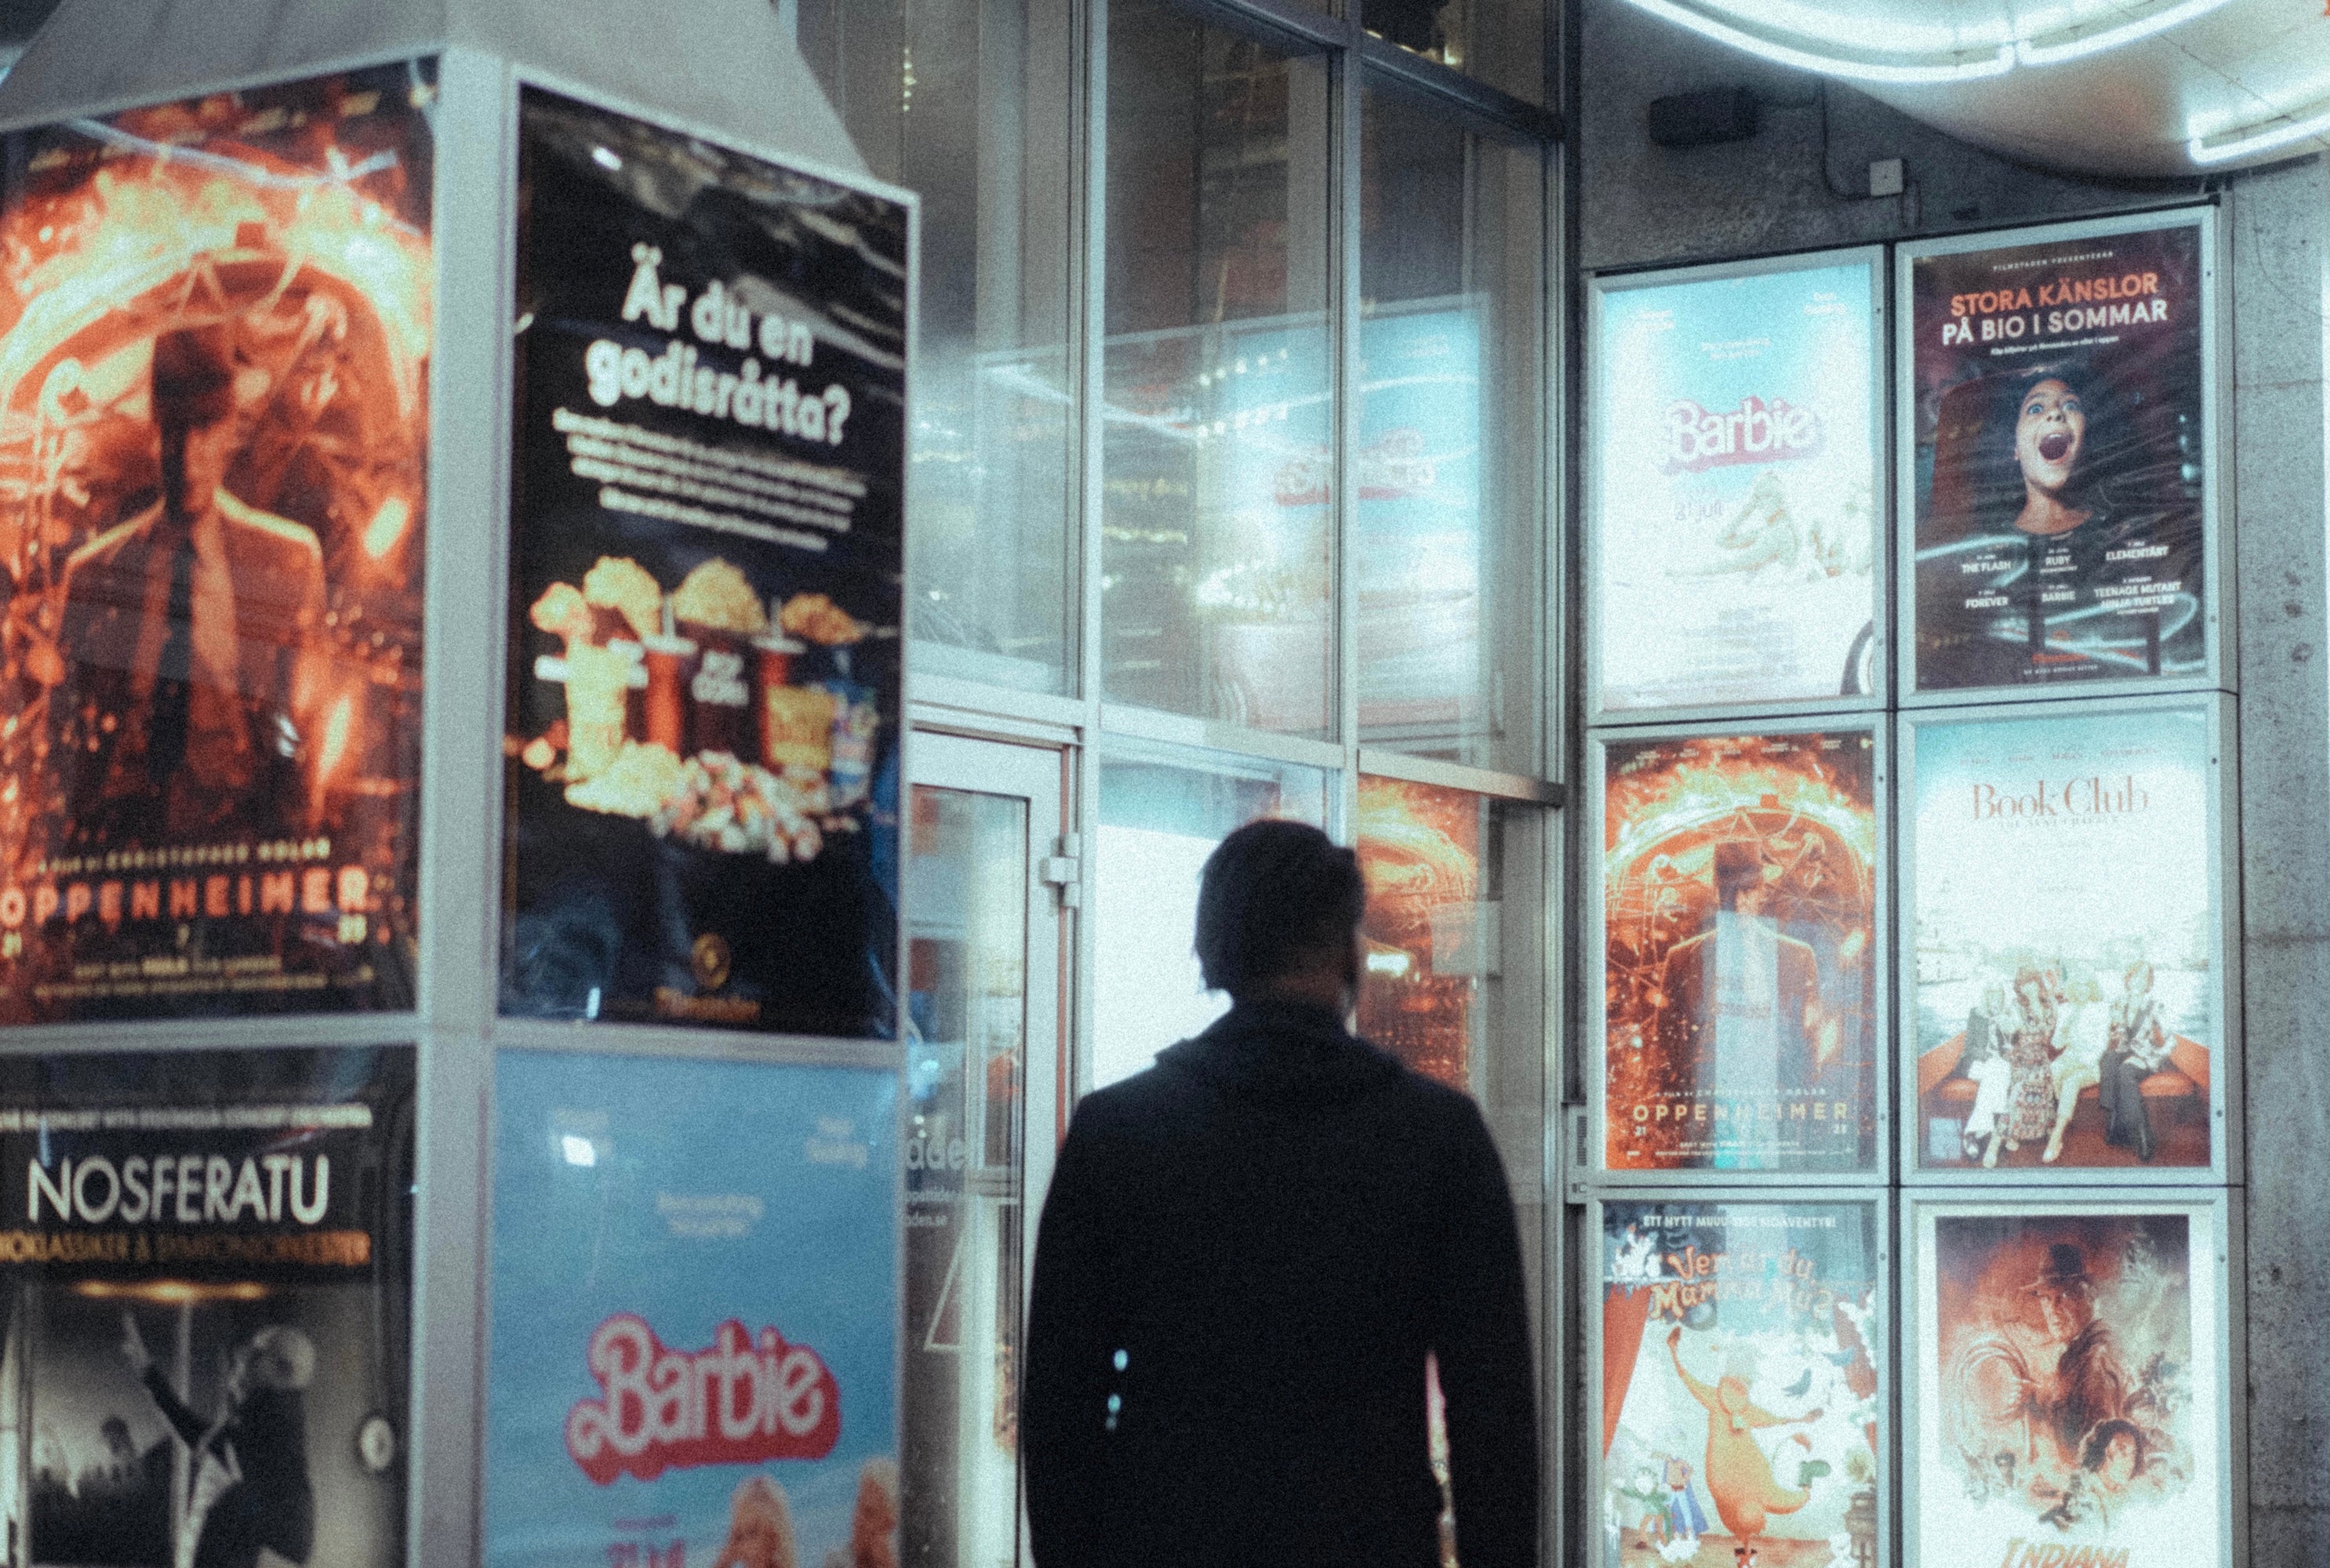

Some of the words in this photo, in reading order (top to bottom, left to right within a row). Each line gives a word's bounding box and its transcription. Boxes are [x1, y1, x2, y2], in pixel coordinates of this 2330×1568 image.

[622, 242, 687, 331] Är
[691, 278, 751, 350] du
[758, 314, 813, 367] en
[1950, 288, 2032, 317] STORA
[2039, 271, 2159, 307] KÄNSLOR
[1942, 317, 1974, 346] PÅ
[1982, 316, 2026, 341] BIO
[2033, 314, 2040, 335] I
[2048, 299, 2168, 334] SOMMAR
[585, 339, 852, 445] godisråtta?
[1661, 397, 1822, 473] Barbie
[1961, 563, 1979, 574] THE
[1981, 561, 2012, 572] FLASH
[2045, 555, 2072, 565] RUBY
[1965, 597, 2009, 608] FOREVER
[2041, 591, 2076, 602] BARBIE
[2140, 581, 2182, 593] MUTANT
[1972, 779, 2057, 820] Book
[2063, 775, 2149, 816] Club
[1632, 1102, 1848, 1122] OPPENHEIMER
[27, 1153, 330, 1225] NOSFERATU
[1643, 1215, 1662, 1228] ETT
[1664, 1215, 1693, 1228] NYTT
[565, 1314, 834, 1474] Barbie
